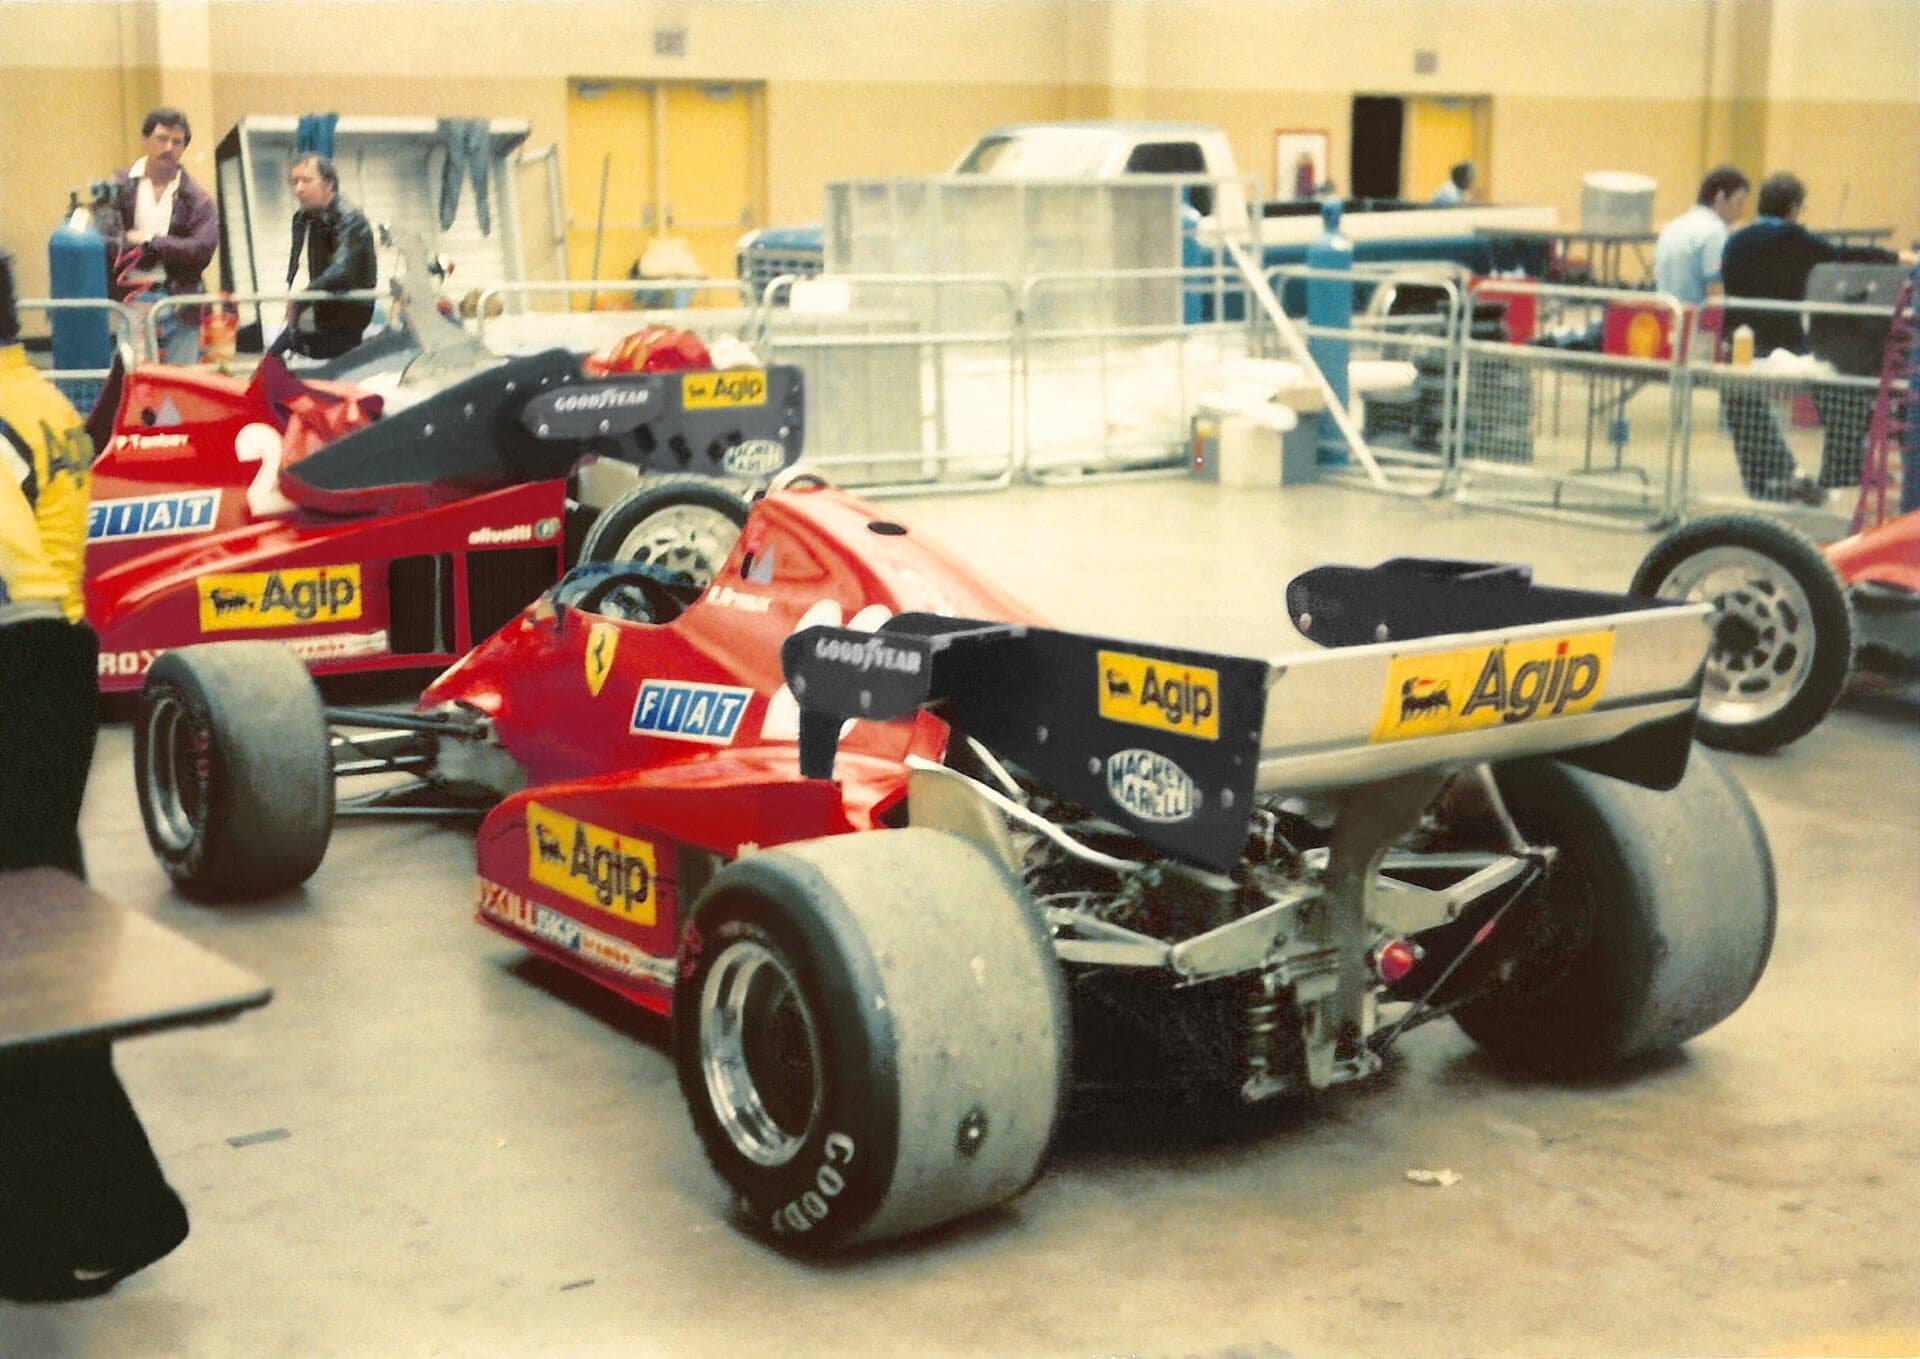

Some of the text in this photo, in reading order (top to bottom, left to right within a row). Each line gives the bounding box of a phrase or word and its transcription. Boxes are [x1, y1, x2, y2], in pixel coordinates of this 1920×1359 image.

[553, 386, 650, 413] GOODYEAR
[713, 377, 762, 402] Agip
[260, 568, 355, 620] Agip
[815, 636, 922, 674] GOODYEAR
[1139, 666, 1213, 727] Agip
[1459, 641, 1601, 723] Agip
[641, 690, 742, 734] FIAT
[569, 823, 649, 912] Agip
